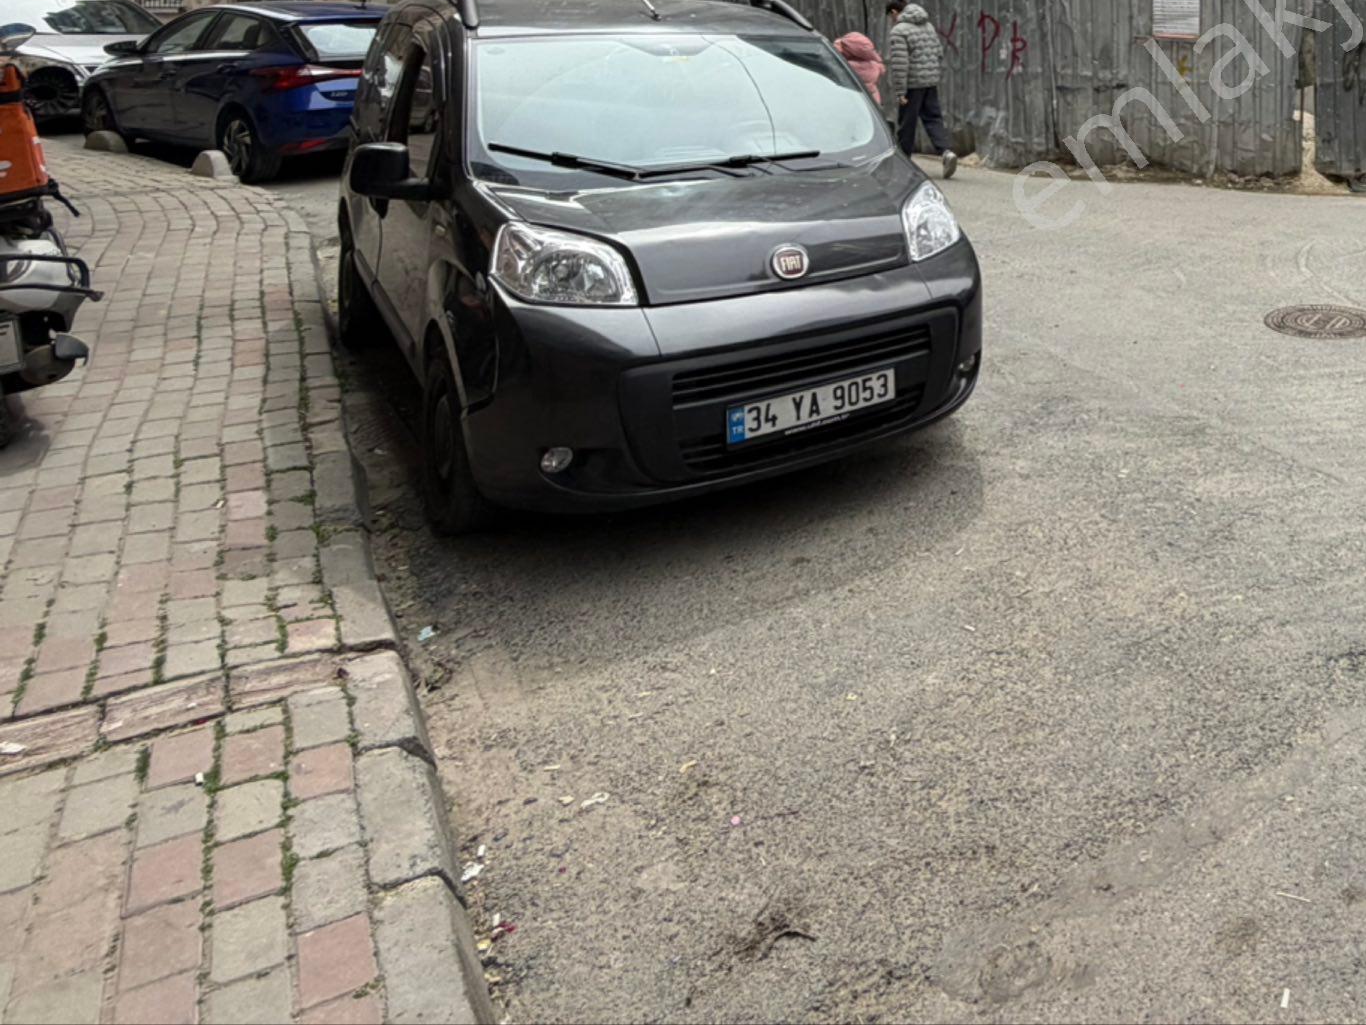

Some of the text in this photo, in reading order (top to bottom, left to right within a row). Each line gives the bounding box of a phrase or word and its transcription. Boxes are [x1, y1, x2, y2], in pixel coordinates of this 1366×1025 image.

[780, 255, 801, 272] FIAT
[747, 403, 778, 433] 34
[792, 391, 820, 422] YA
[832, 373, 889, 411] 9053
